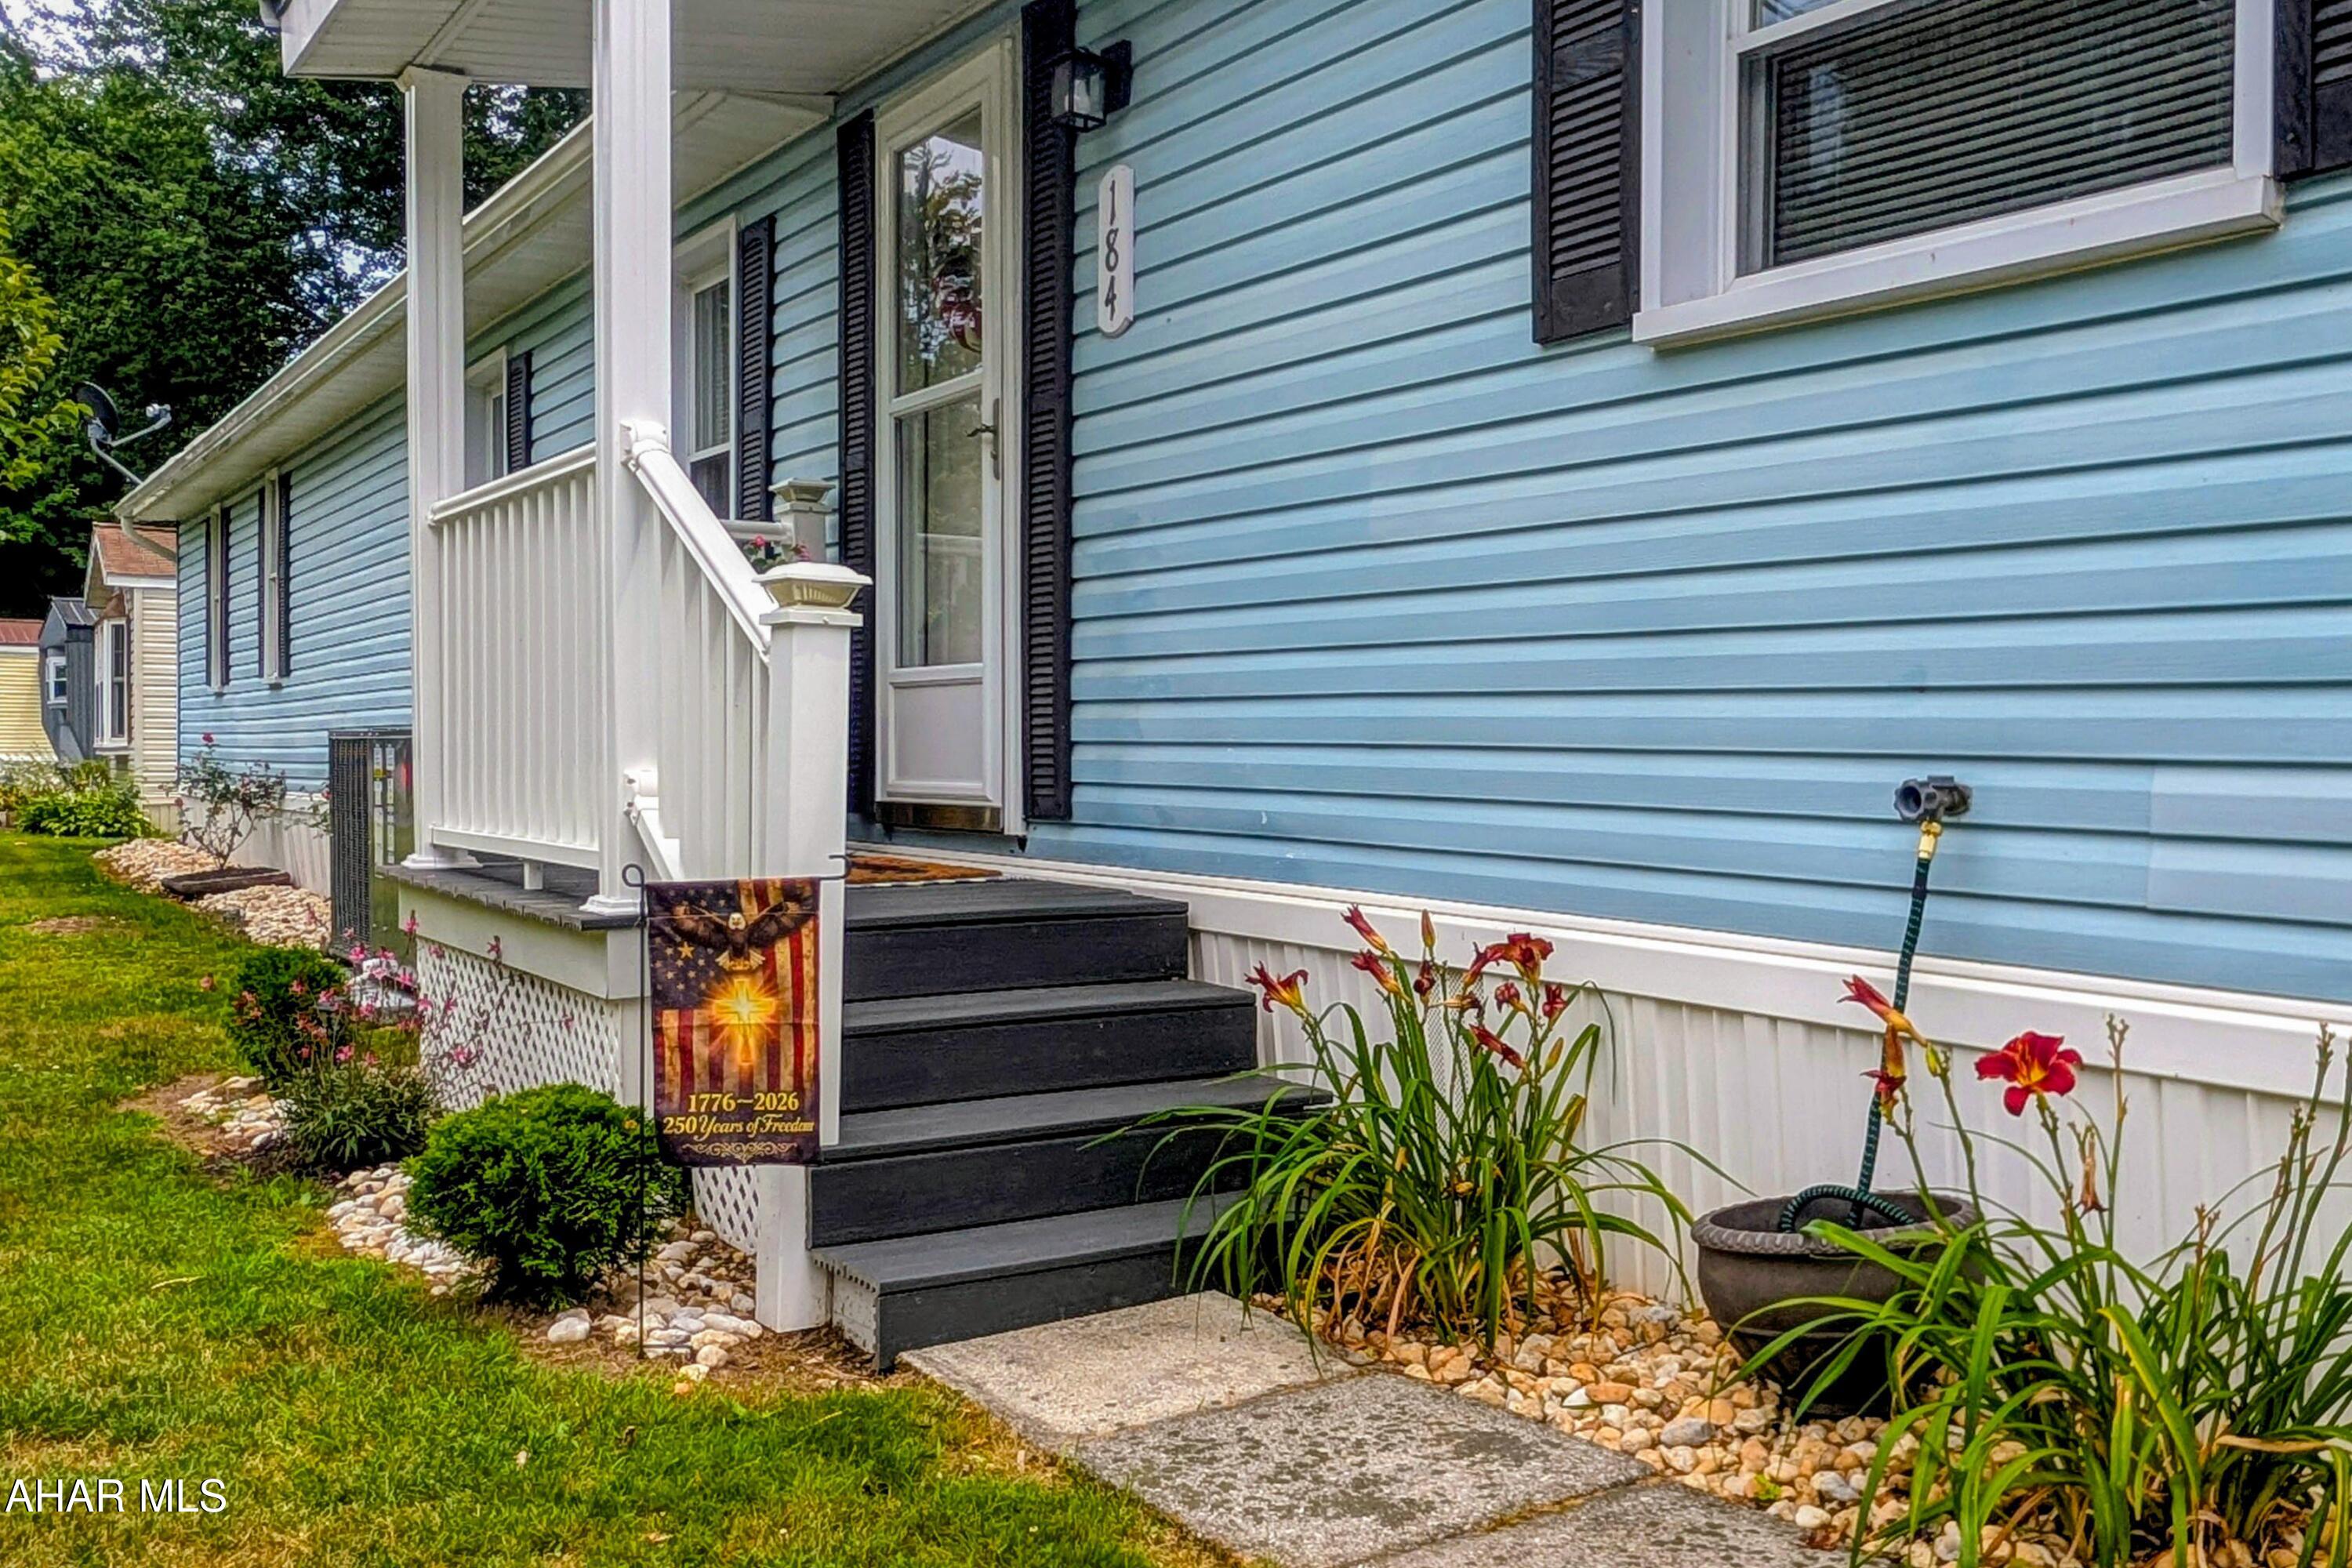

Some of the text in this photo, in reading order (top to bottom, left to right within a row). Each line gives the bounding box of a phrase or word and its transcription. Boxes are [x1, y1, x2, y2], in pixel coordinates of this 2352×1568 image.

[1105, 180, 1119, 321] 184
[662, 1113, 814, 1142] 250 Years of Freedom
